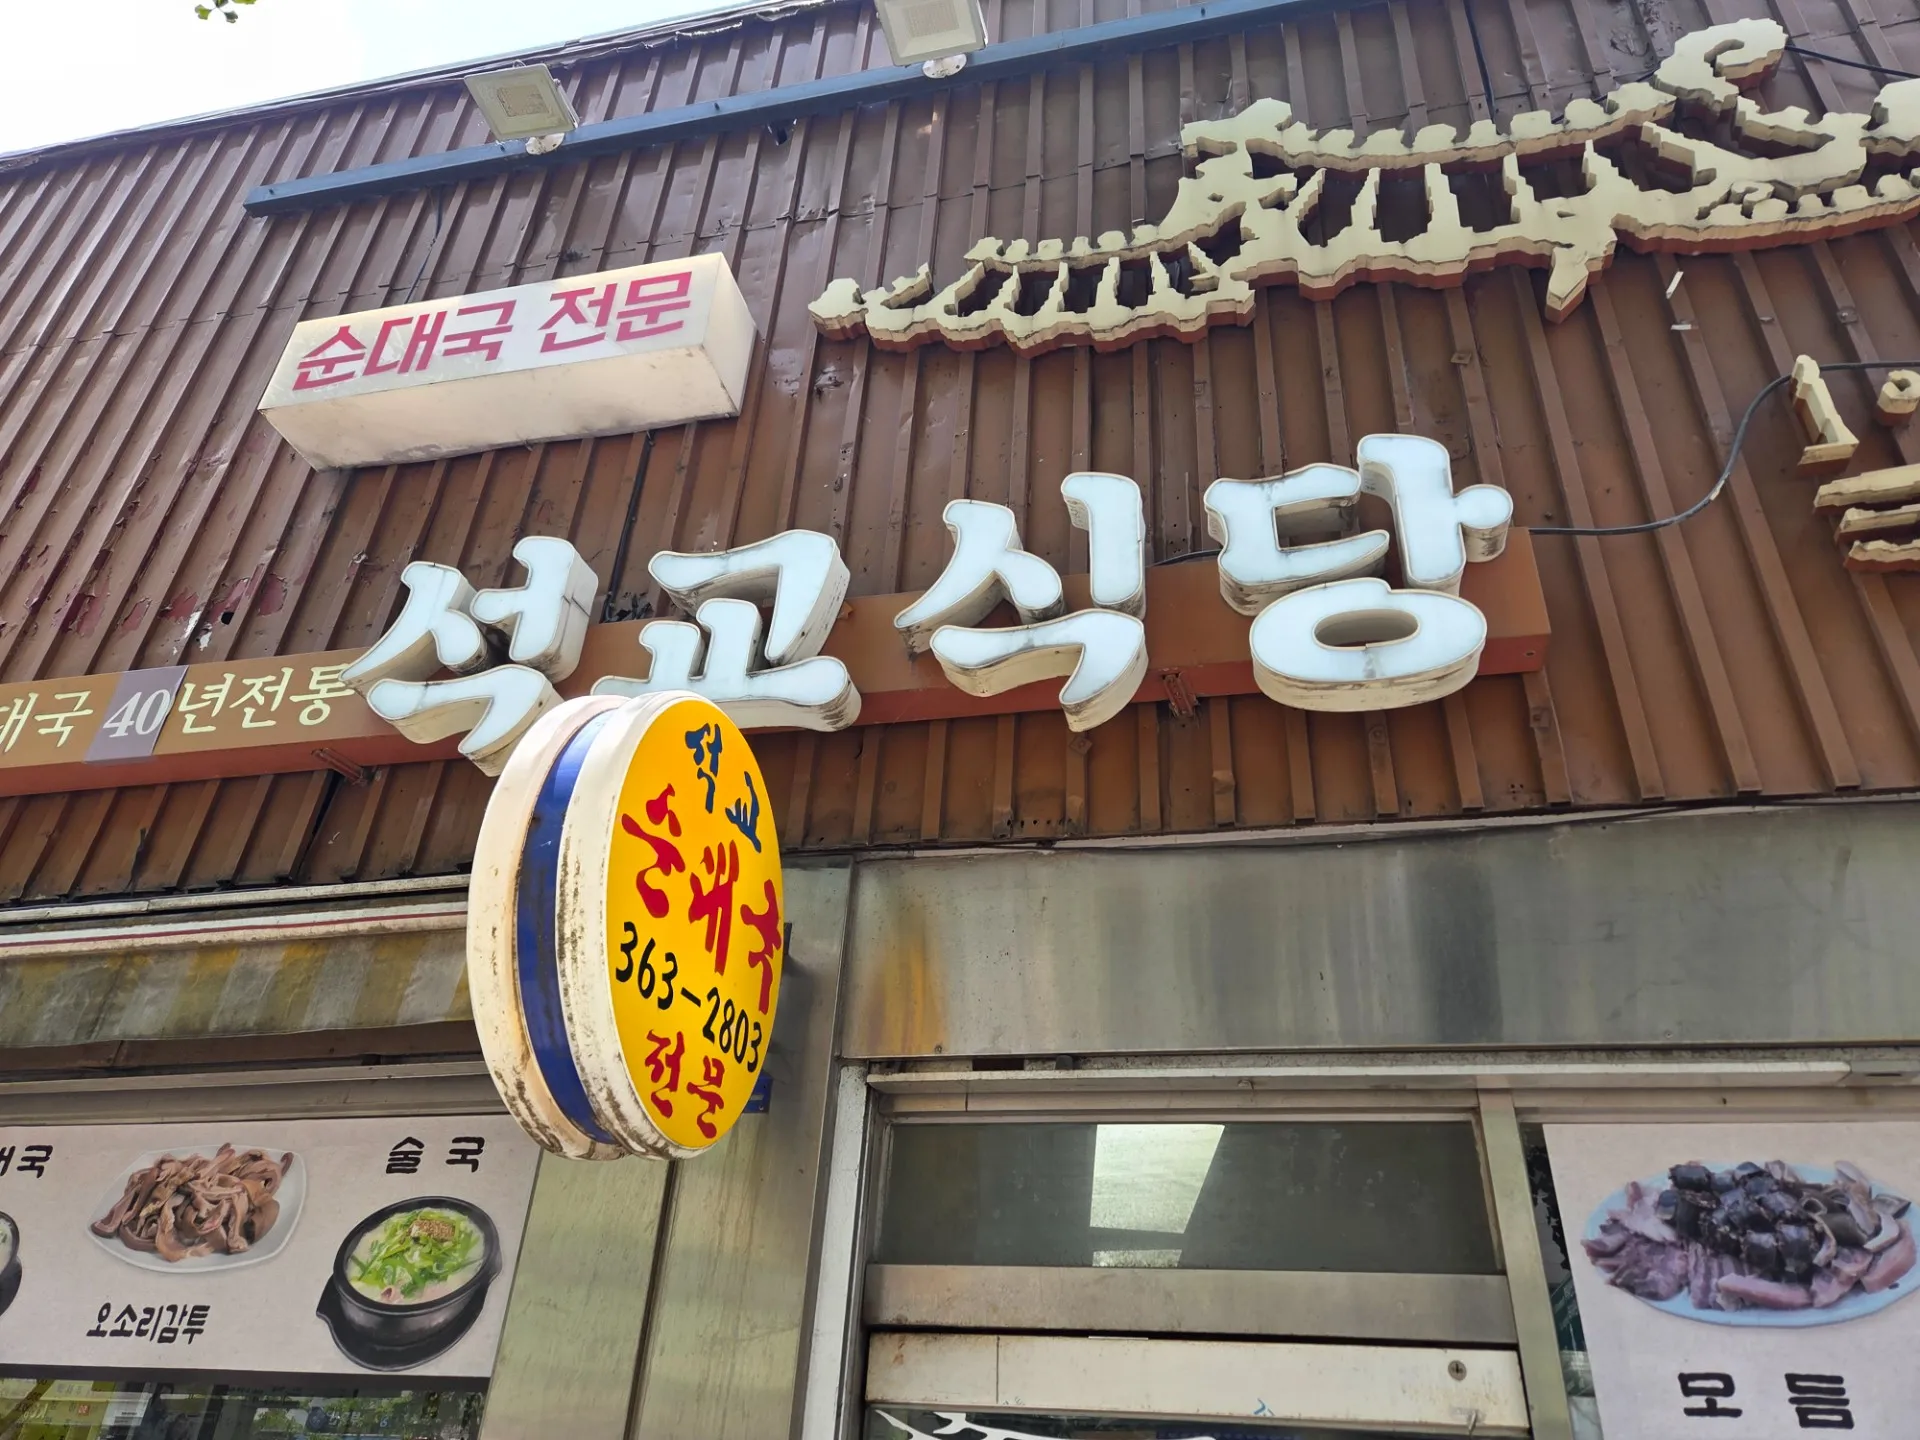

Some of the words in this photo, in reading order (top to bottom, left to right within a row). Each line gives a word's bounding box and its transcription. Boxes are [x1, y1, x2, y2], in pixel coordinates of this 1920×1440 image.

[292, 300, 518, 391] 순대국
[537, 271, 693, 354] 전문
[341, 433, 1513, 777] 석교식당
[621, 783, 782, 1015] 순대국
[615, 921, 763, 1073] 363-2803
[644, 1027, 725, 1139] 전문
[86, 1303, 211, 1345] 오소리감투
